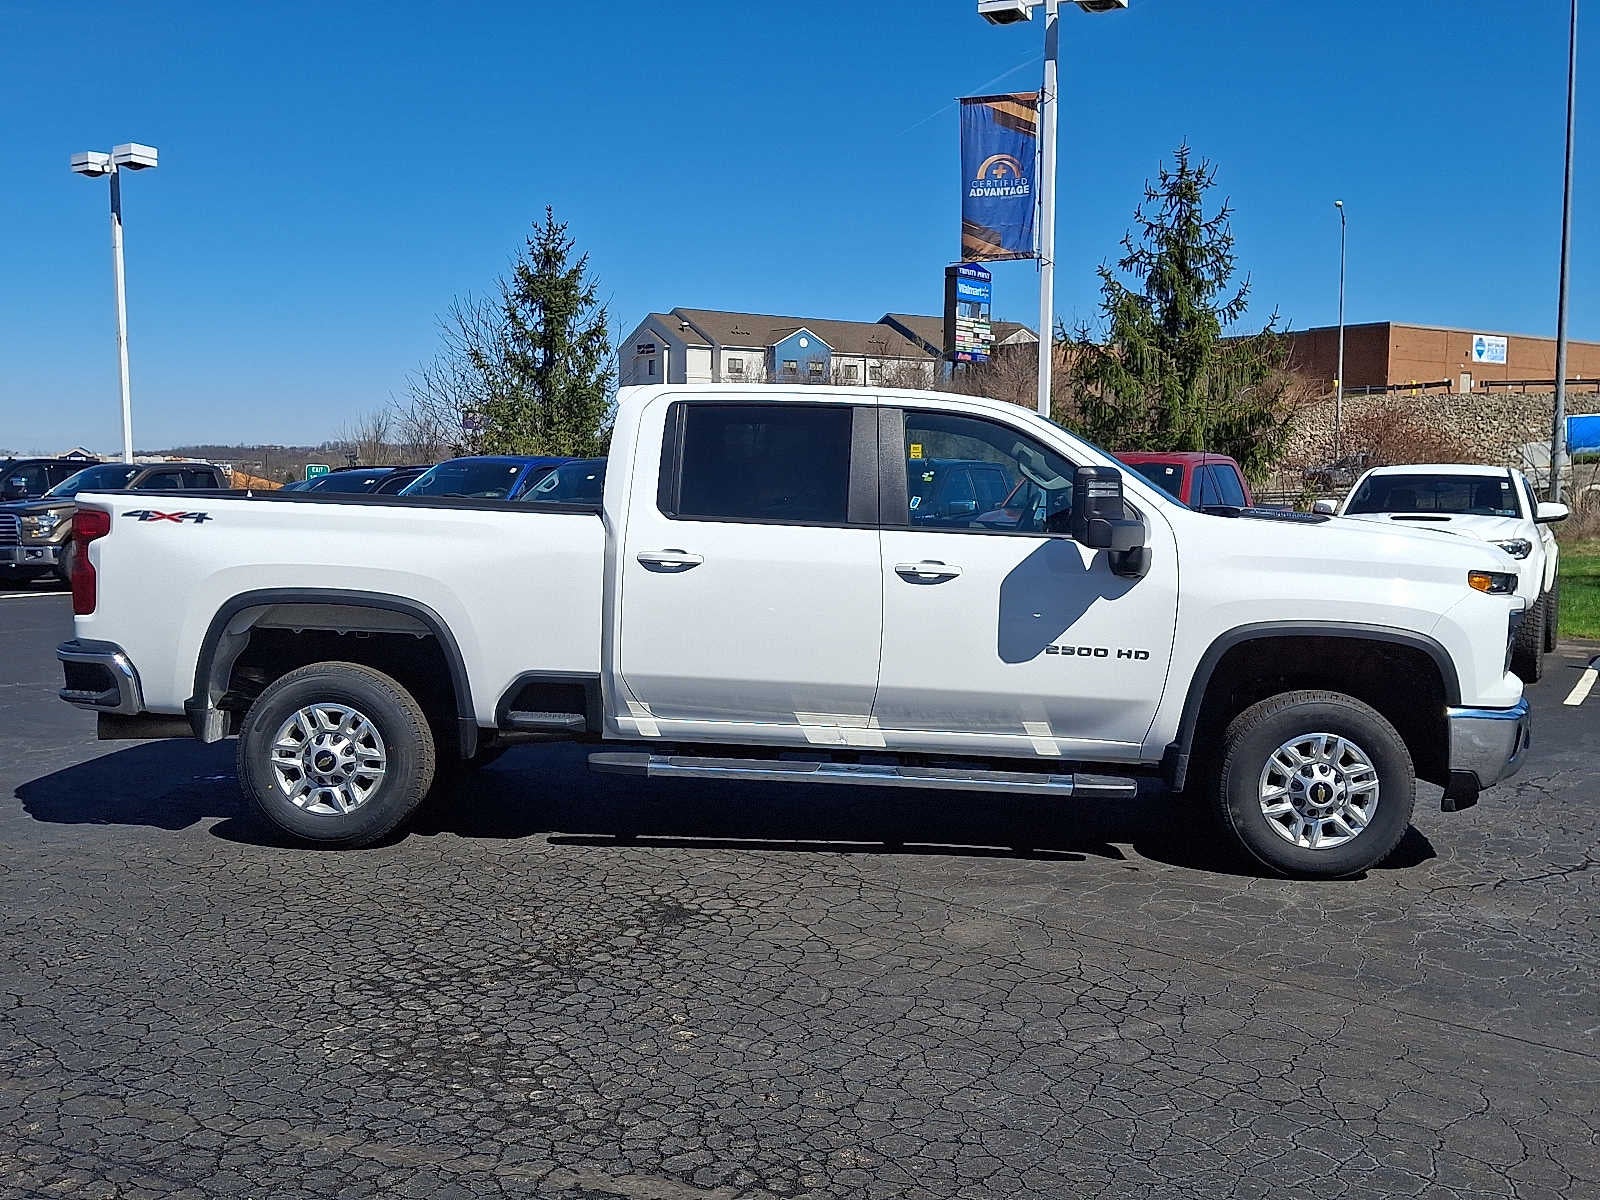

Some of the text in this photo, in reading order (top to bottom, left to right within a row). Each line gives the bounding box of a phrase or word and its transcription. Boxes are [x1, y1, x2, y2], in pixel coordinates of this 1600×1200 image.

[971, 178, 1028, 188] CERTIFIED
[969, 185, 1030, 197] ADVANTAGE
[958, 283, 984, 297] Walmart
[1045, 645, 1150, 661] 2500 HD
